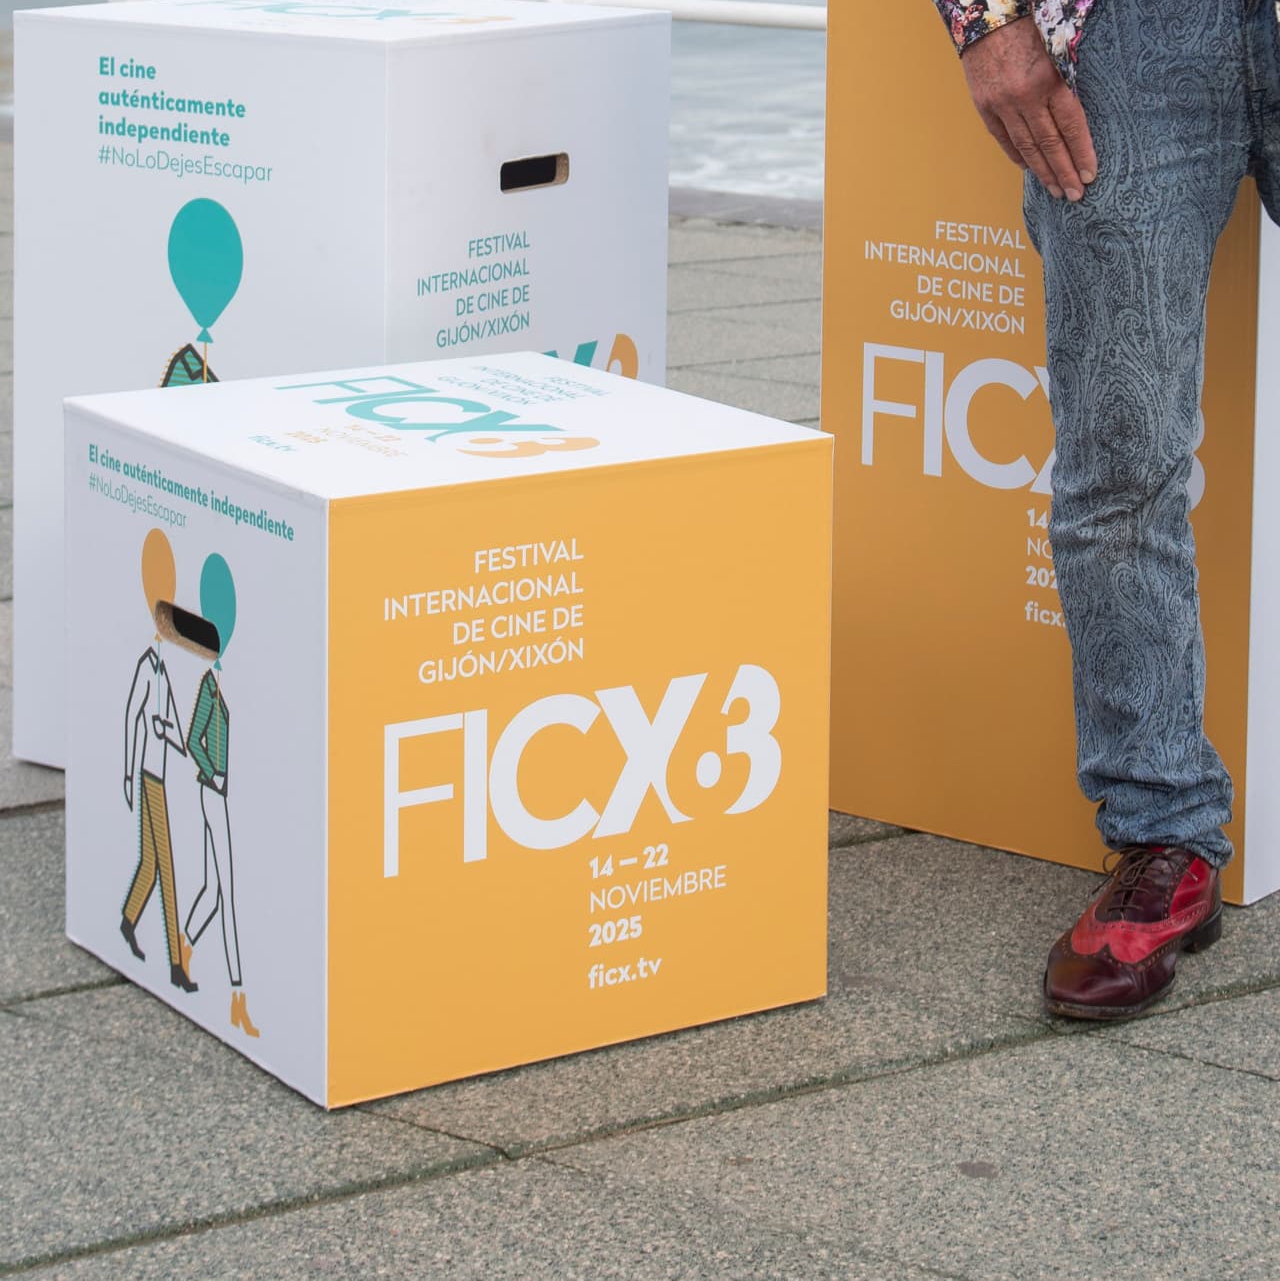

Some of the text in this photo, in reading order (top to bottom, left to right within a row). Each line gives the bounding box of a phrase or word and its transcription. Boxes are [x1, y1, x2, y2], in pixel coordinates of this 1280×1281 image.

[99, 56, 157, 80] El cine
[99, 89, 246, 118] auténticamente
[99, 115, 230, 147] independiente
[98, 144, 273, 184] #NoLoDejesEscapar
[468, 231, 530, 258] FESTIVAL
[935, 221, 1026, 249] FESTIVAL
[864, 240, 1025, 278] INTERNACIONAL
[416, 258, 530, 296] INTERNACIONAL
[918, 275, 1025, 306] DE CINE DE
[456, 284, 530, 316] DE CINE DE
[890, 300, 1025, 334] GIJÓN/XIXÓN
[436, 311, 530, 348] GIJÓN/XIXÓN
[89, 444, 294, 541] El cine auténticamente independiente
[89, 472, 187, 527] #NoLoDejesEscapar
[474, 538, 584, 574] FESTIVAL
[1025, 565, 1058, 590] 202
[384, 571, 584, 621] INTERNACIONAL
[453, 604, 584, 645] DE CINE DE
[418, 636, 584, 684] GIJÓN/XIXÓN
[589, 854, 614, 878] 14
[643, 844, 669, 869] 22
[590, 865, 727, 913] NOVIEMBRE
[589, 915, 642, 947] 2025
[588, 958, 662, 989] ficx.tv
